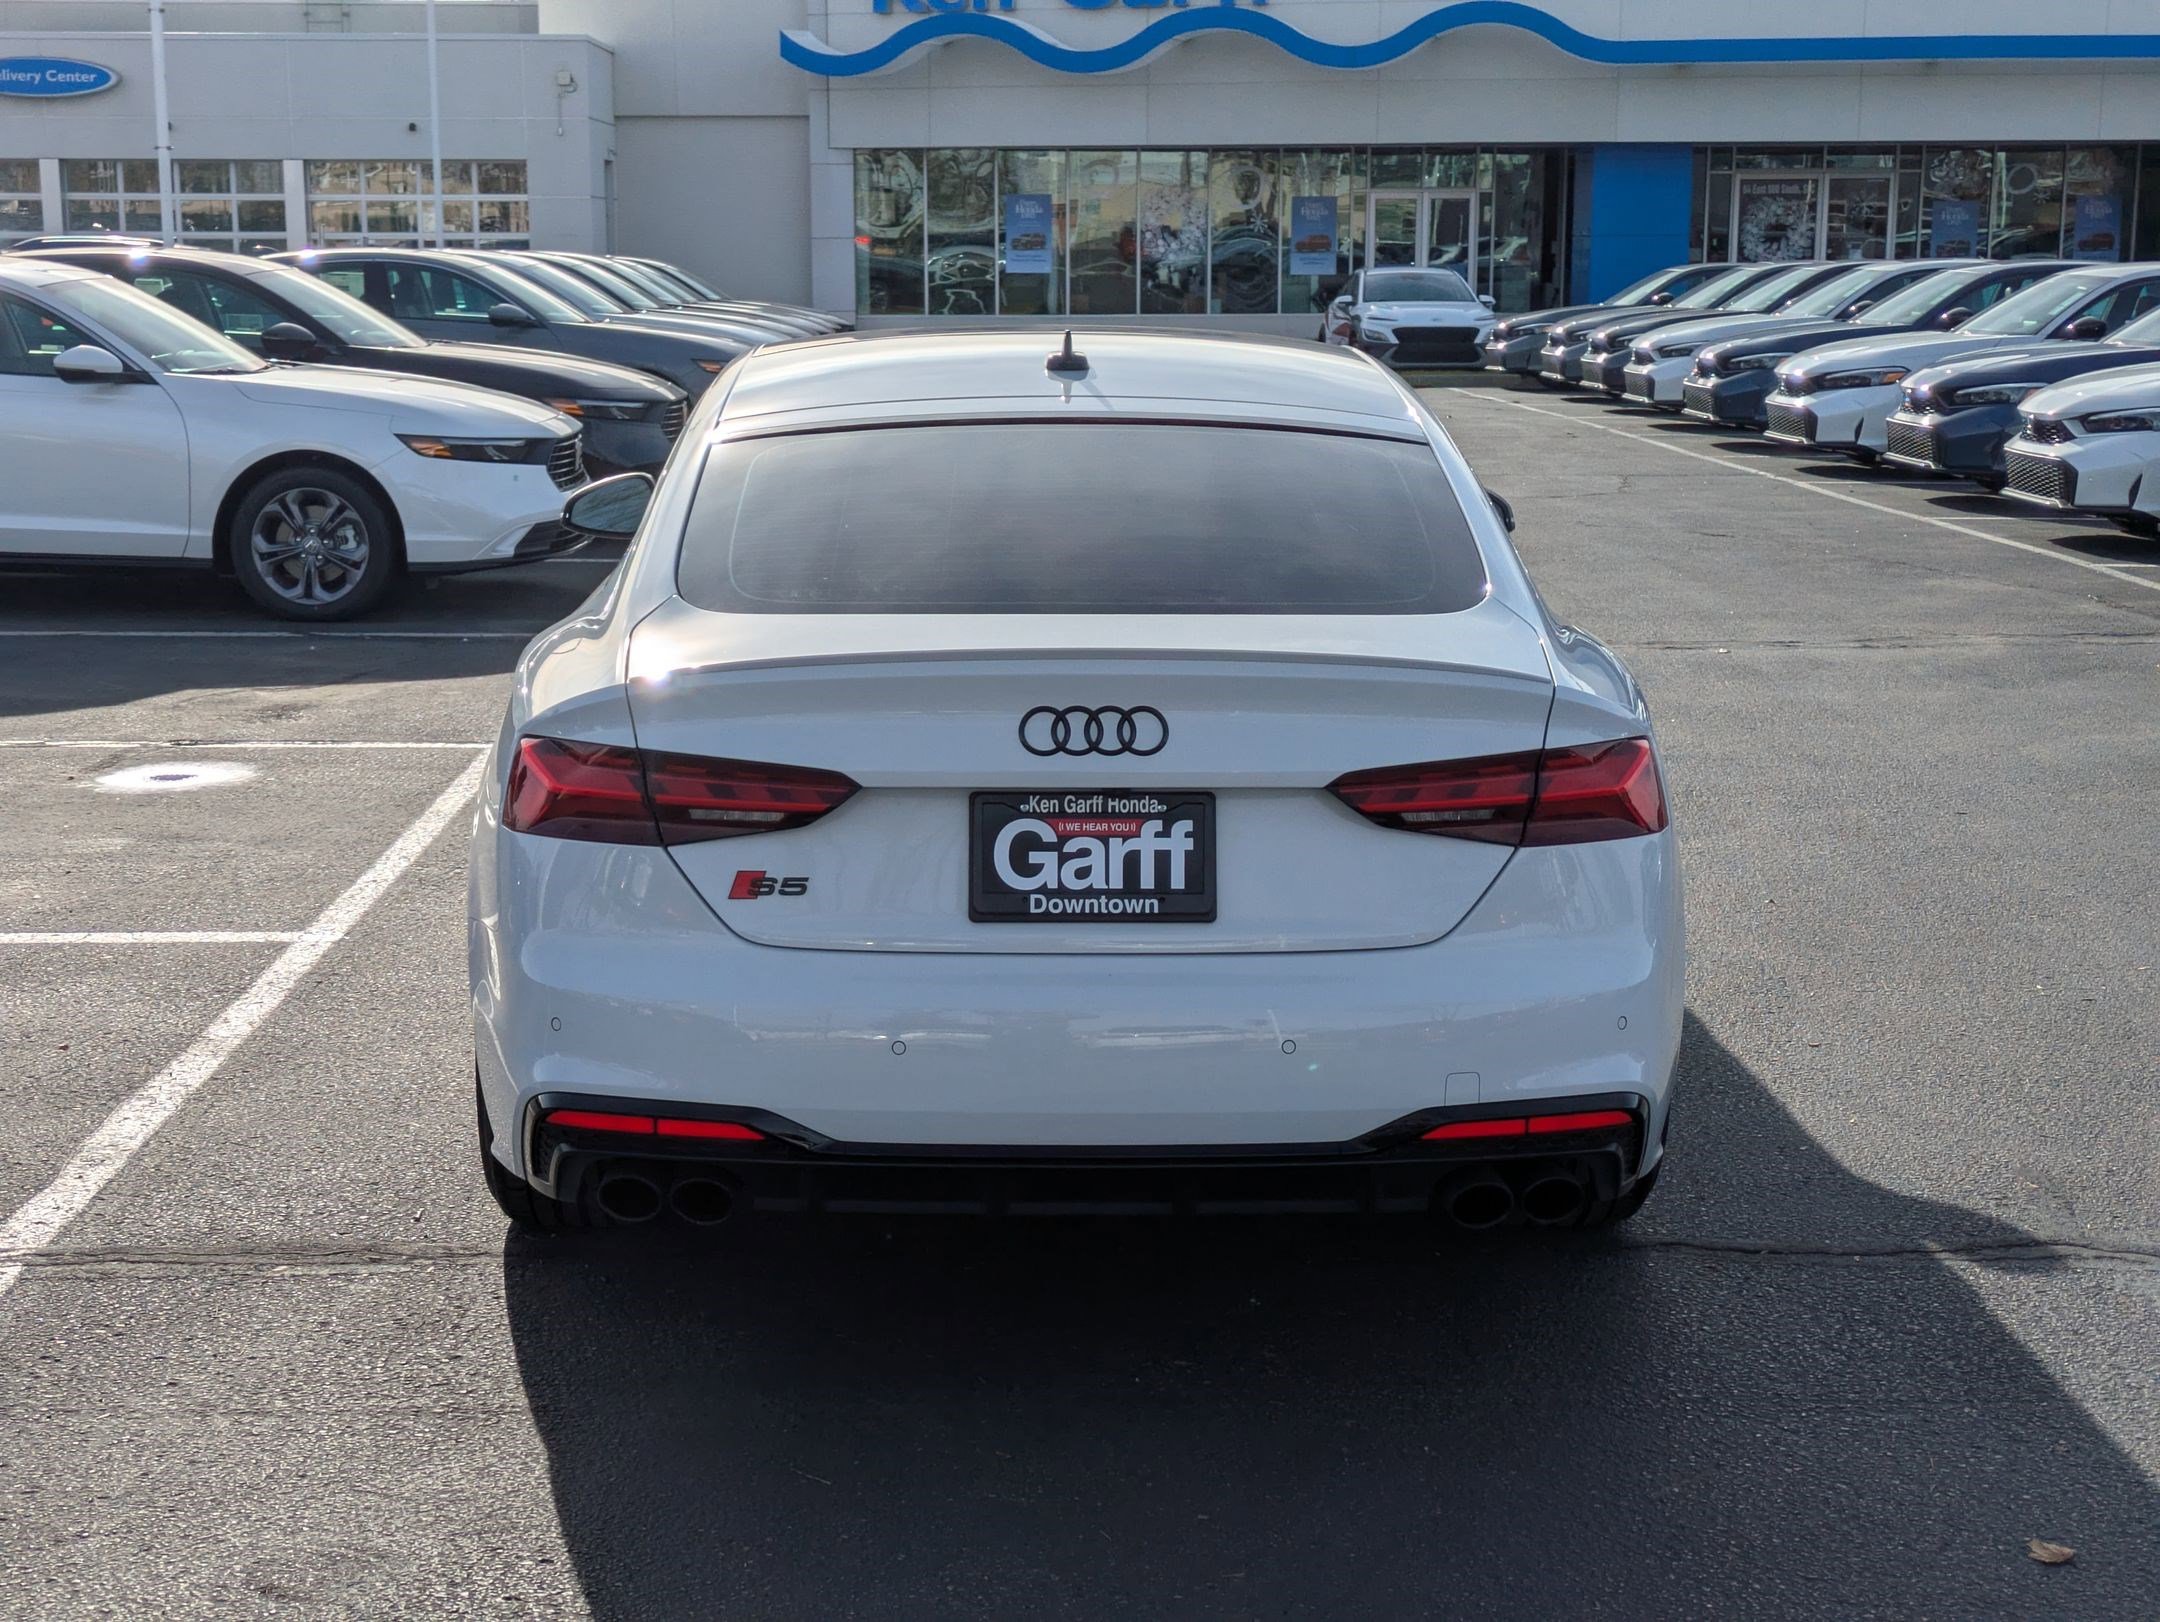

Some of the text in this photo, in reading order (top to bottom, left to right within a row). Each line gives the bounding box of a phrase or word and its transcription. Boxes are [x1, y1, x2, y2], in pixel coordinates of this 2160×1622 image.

[0, 68, 97, 84] livery Center
[1029, 795, 1158, 813] Ken Garff Honda
[1066, 822, 1129, 831] WE HEAR YOU
[993, 818, 1194, 891] Garff
[747, 877, 809, 896] S5
[1029, 894, 1159, 914] Downtown
